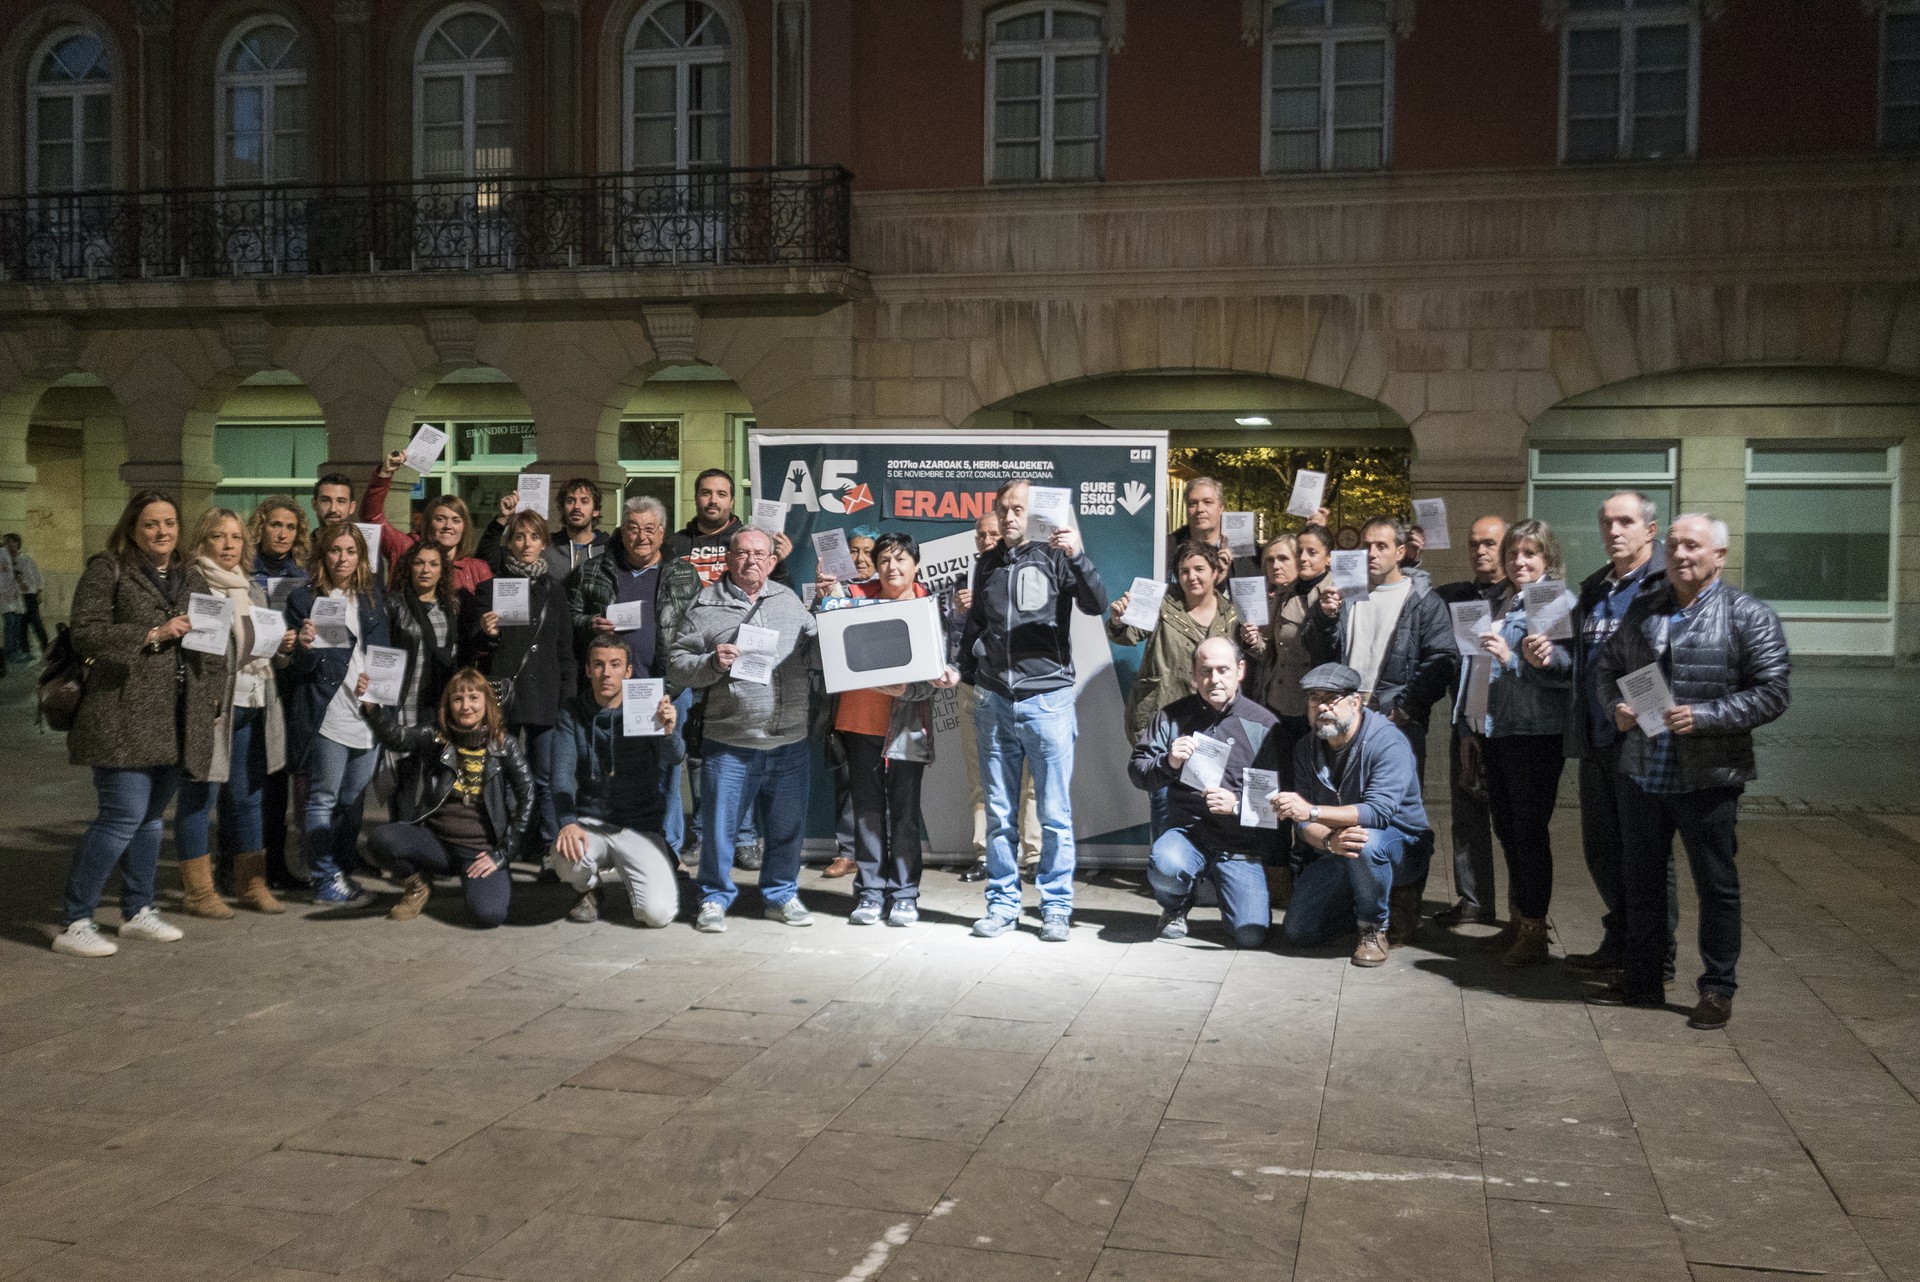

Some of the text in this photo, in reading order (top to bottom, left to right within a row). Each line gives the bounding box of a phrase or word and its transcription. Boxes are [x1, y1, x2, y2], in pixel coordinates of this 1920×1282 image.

[887, 460, 1054, 470] 2017ko AZAROAK 5, HERRI-GALDEKETA
[887, 470, 1053, 479] 5 DE NOVIEMBRE DE 2017, CONSULTA CIUDADANA
[779, 459, 858, 514] A5
[1080, 481, 1116, 493] GURE
[1080, 493, 1116, 504] ESKU
[1080, 504, 1116, 516] DAGO
[926, 555, 970, 578] DUZU
